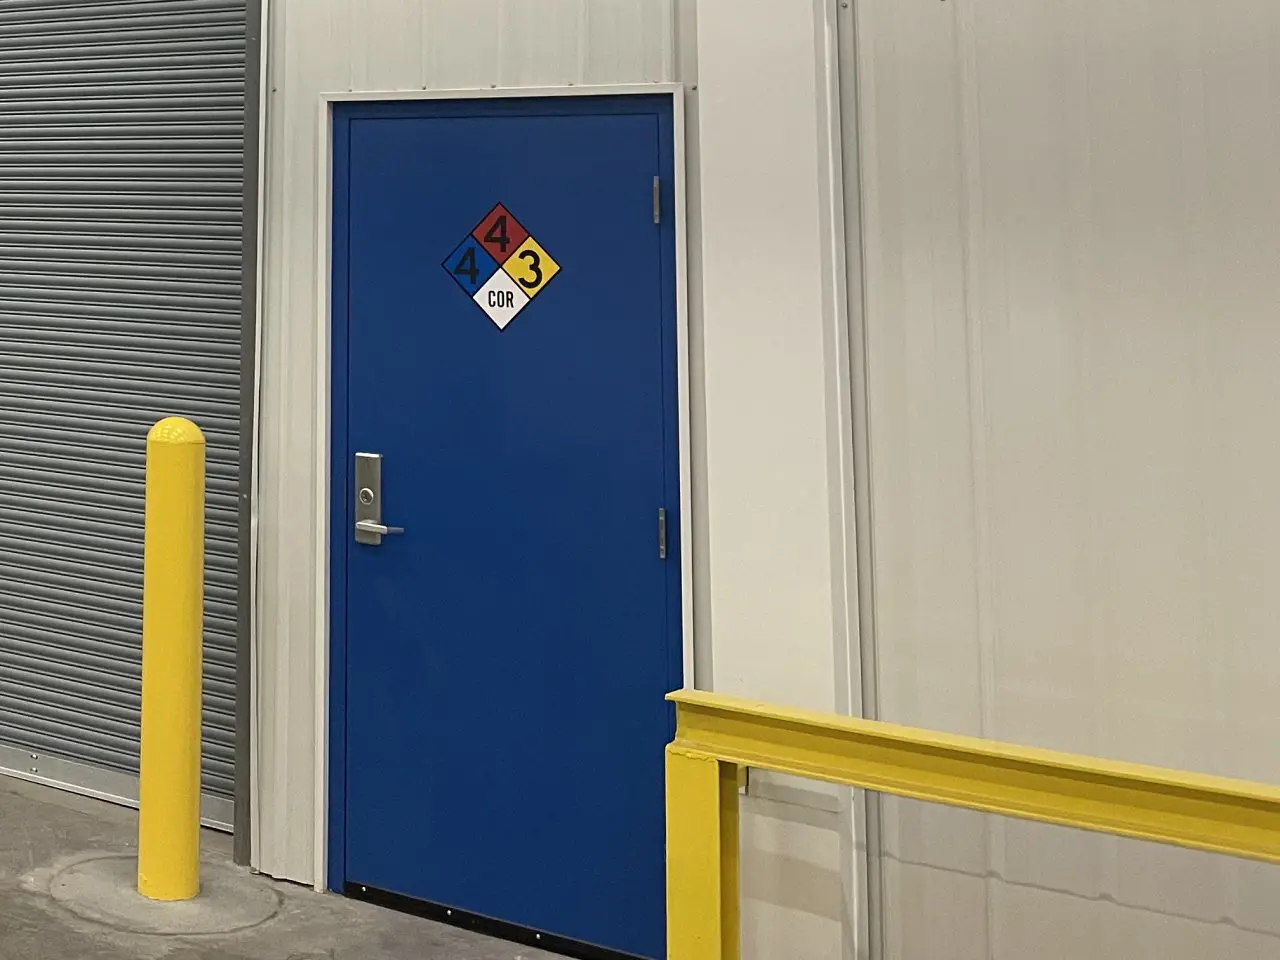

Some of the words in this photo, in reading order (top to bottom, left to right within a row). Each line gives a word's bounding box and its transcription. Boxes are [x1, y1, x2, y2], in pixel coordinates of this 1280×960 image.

[484, 215, 511, 252] 4
[453, 247, 479, 285] 4
[518, 249, 543, 289] 3
[488, 290, 514, 308] COR
